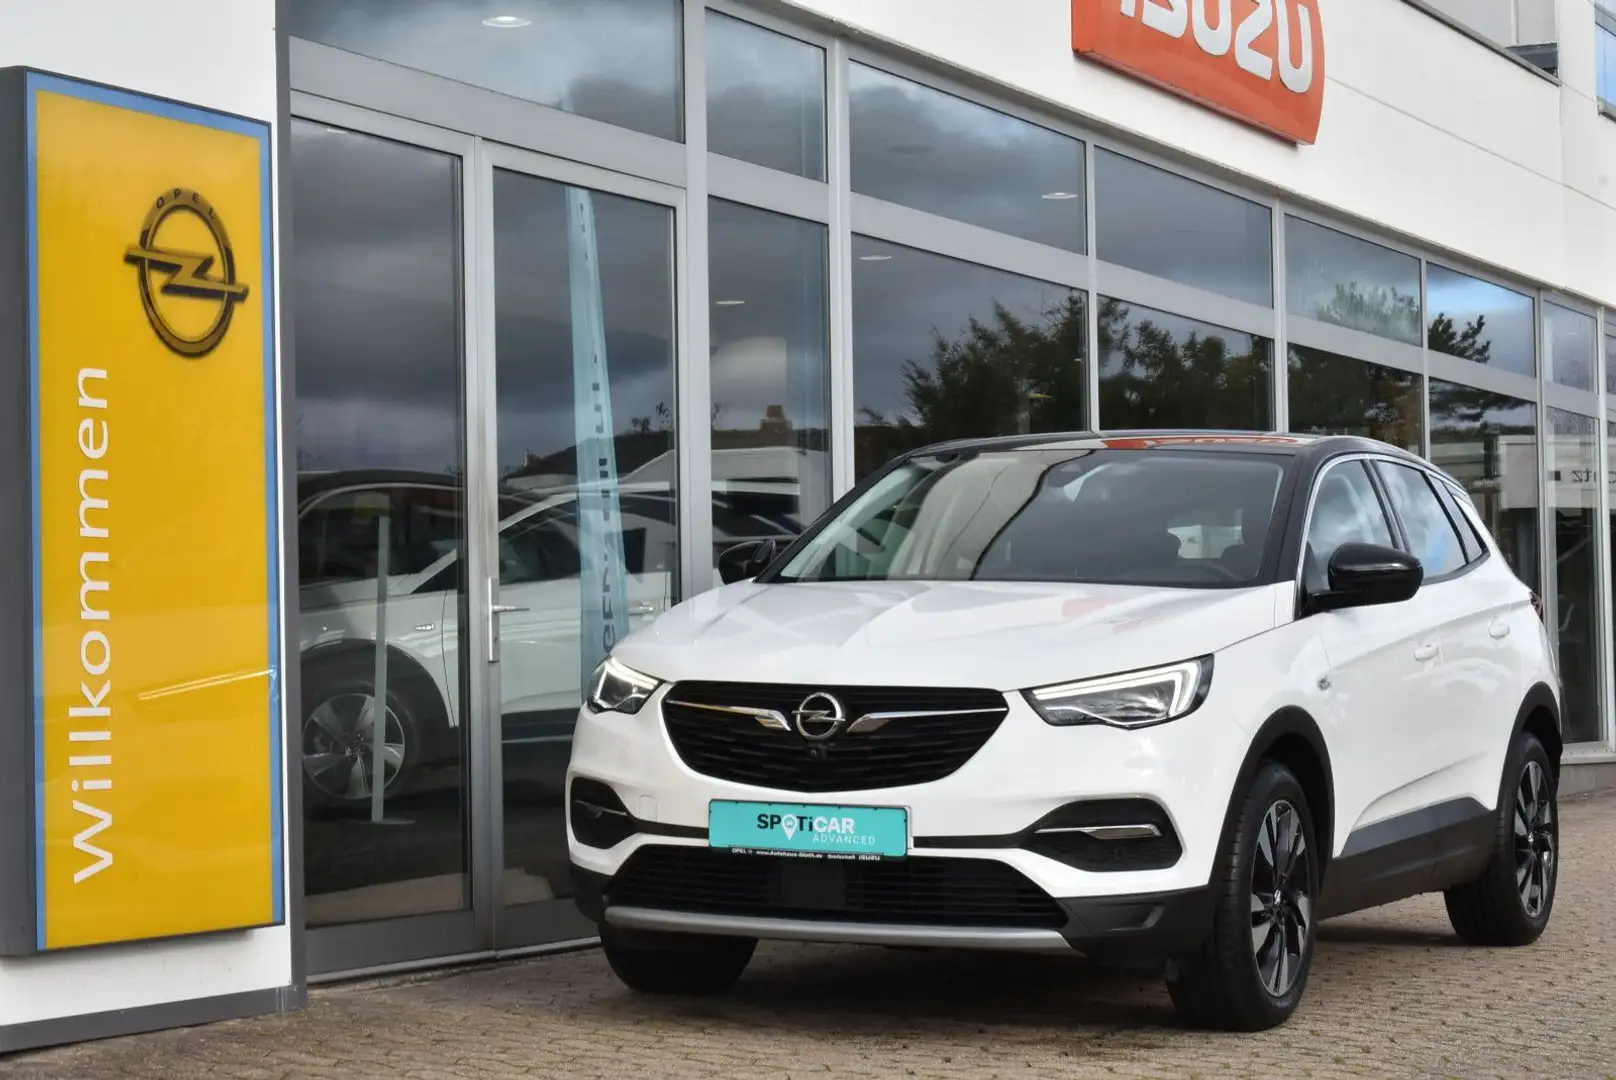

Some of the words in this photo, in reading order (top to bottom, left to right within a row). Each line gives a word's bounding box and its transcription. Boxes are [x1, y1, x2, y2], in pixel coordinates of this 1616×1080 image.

[1120, 0, 1313, 94] UZU
[155, 187, 217, 220] OPEL
[68, 366, 114, 884] Willkommen
[812, 833, 876, 846] ADVANCED
